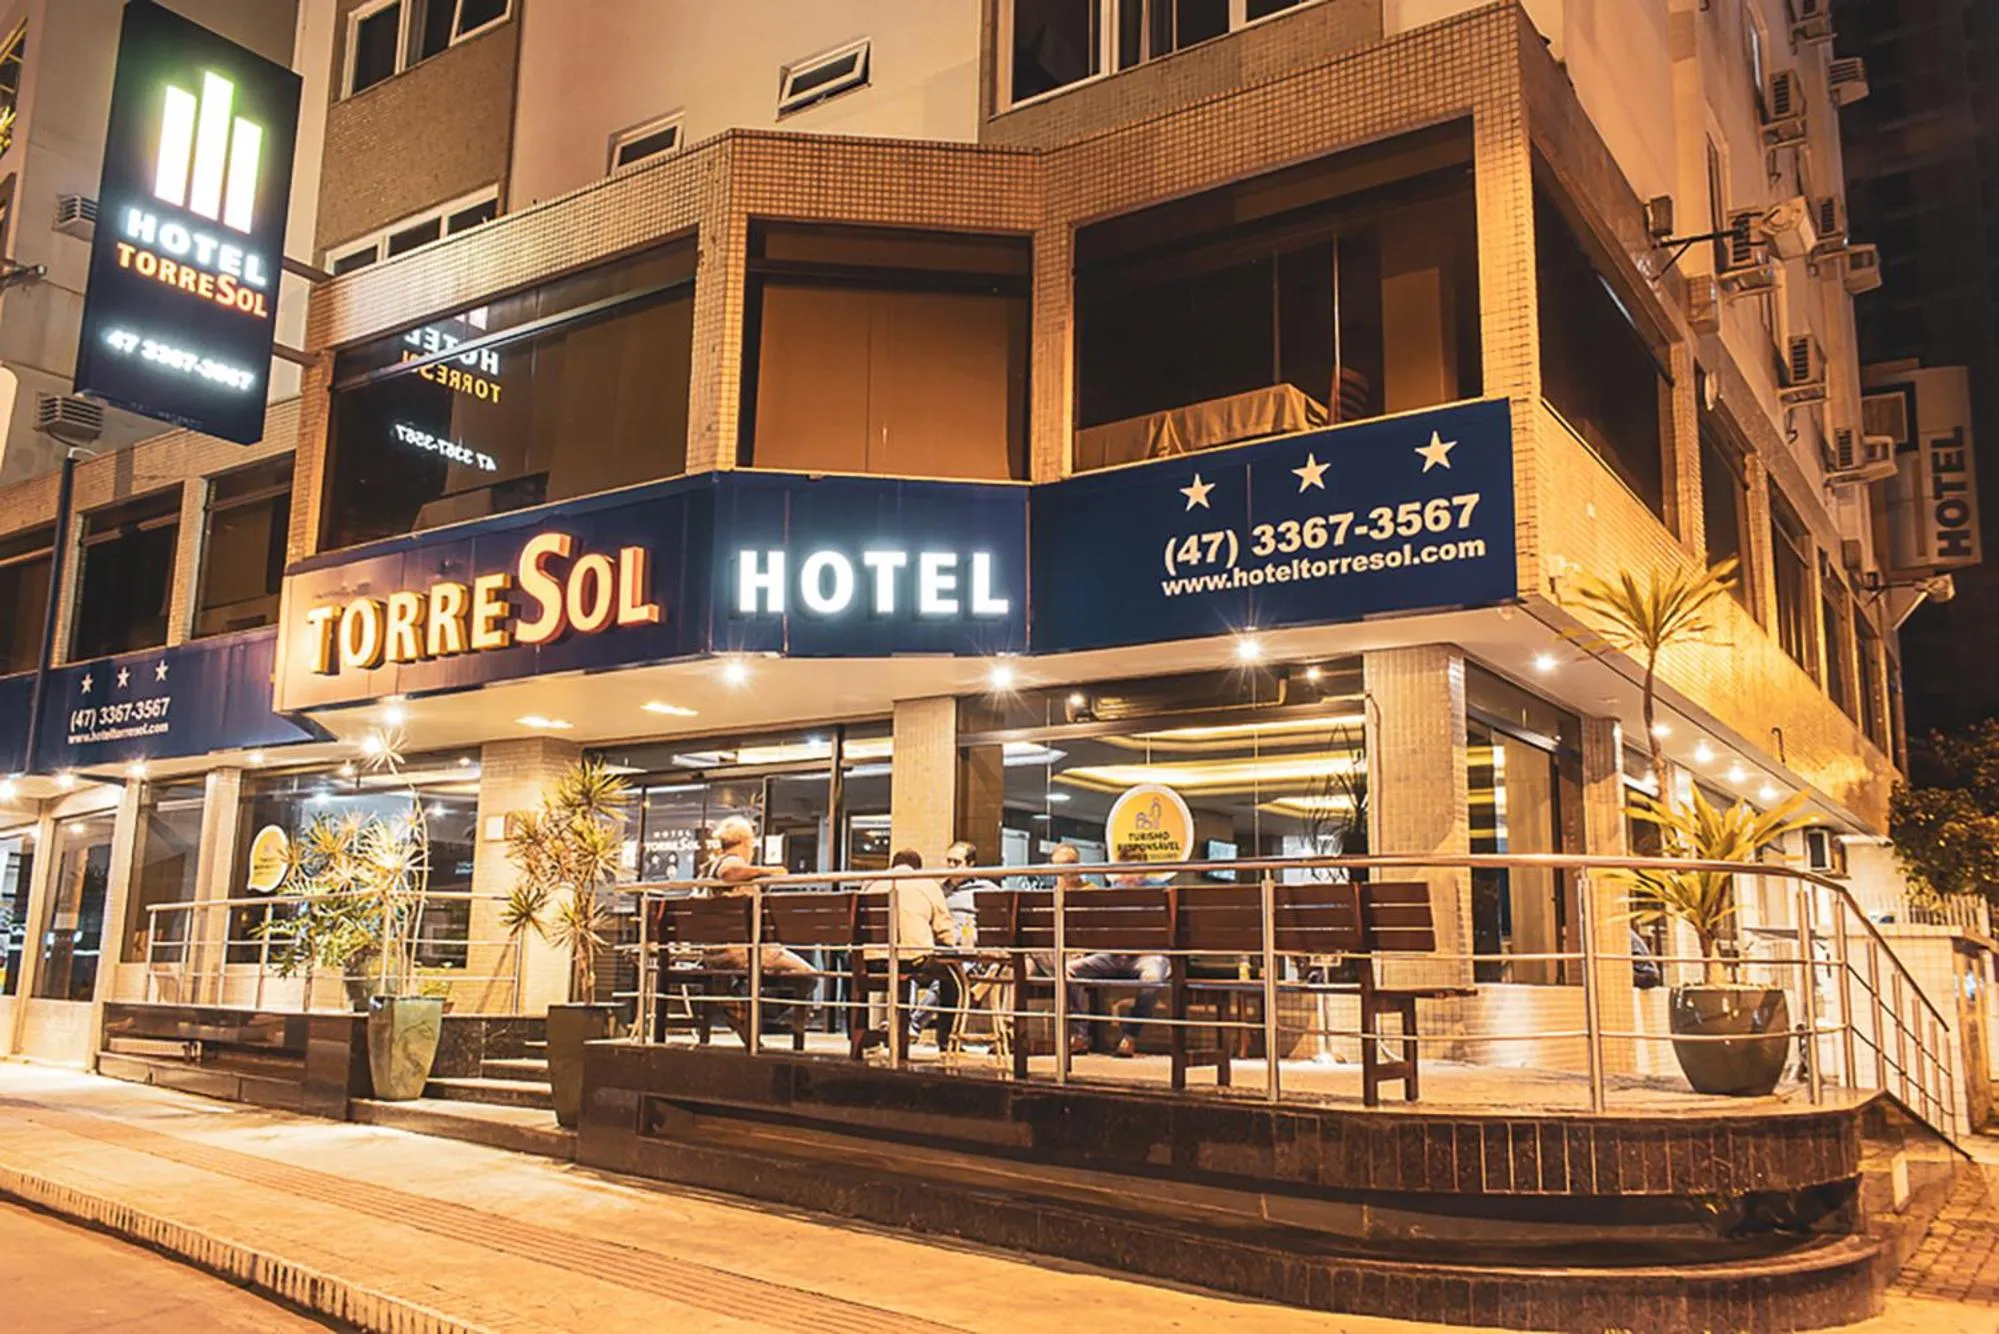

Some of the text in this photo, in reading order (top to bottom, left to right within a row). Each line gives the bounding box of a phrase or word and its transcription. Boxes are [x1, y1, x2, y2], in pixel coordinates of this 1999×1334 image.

[116, 241, 269, 318] TORRESOL
[126, 207, 267, 287] HOTEL
[1931, 425, 1973, 557] HOTEL
[1161, 537, 1487, 597] www.hoteltorresol.com
[1163, 493, 1480, 576] (47) 3367-3567
[306, 531, 661, 675] TORRESOL
[737, 549, 1010, 615] HOTEL
[69, 696, 170, 733] (47) 3367-3567
